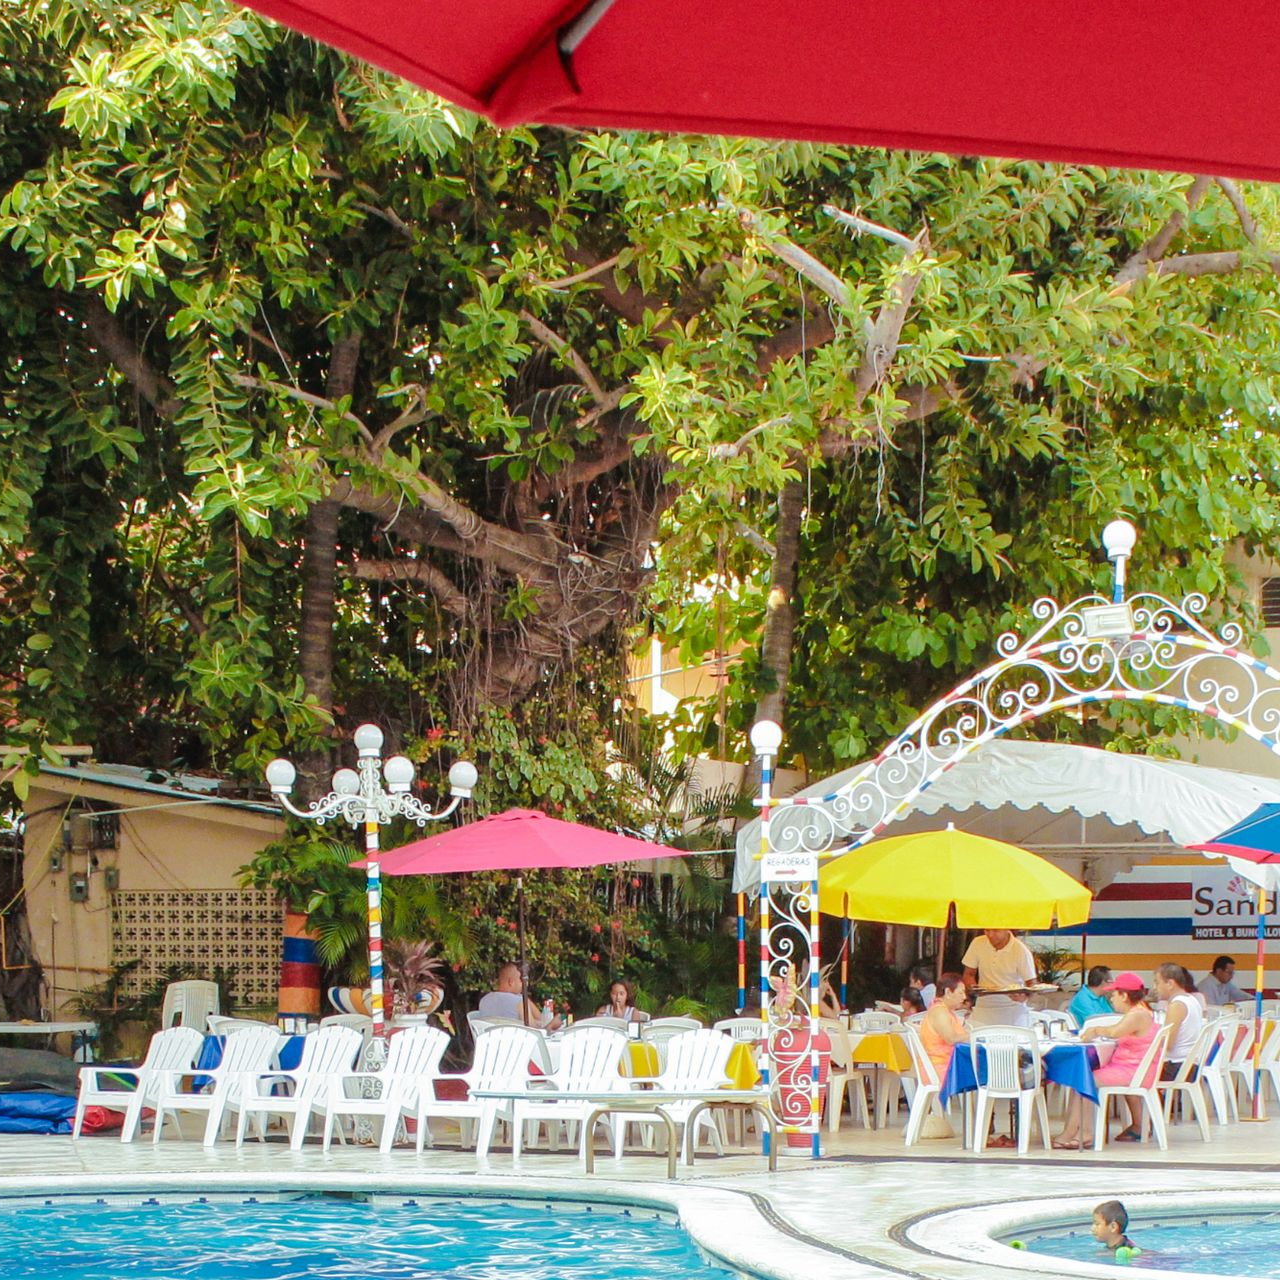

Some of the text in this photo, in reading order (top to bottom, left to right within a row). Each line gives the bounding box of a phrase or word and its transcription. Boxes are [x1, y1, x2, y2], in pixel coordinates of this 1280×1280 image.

[767, 857, 810, 866] REGADERAS
[1195, 928, 1224, 938] HOTEL
[1227, 928, 1233, 937] &
